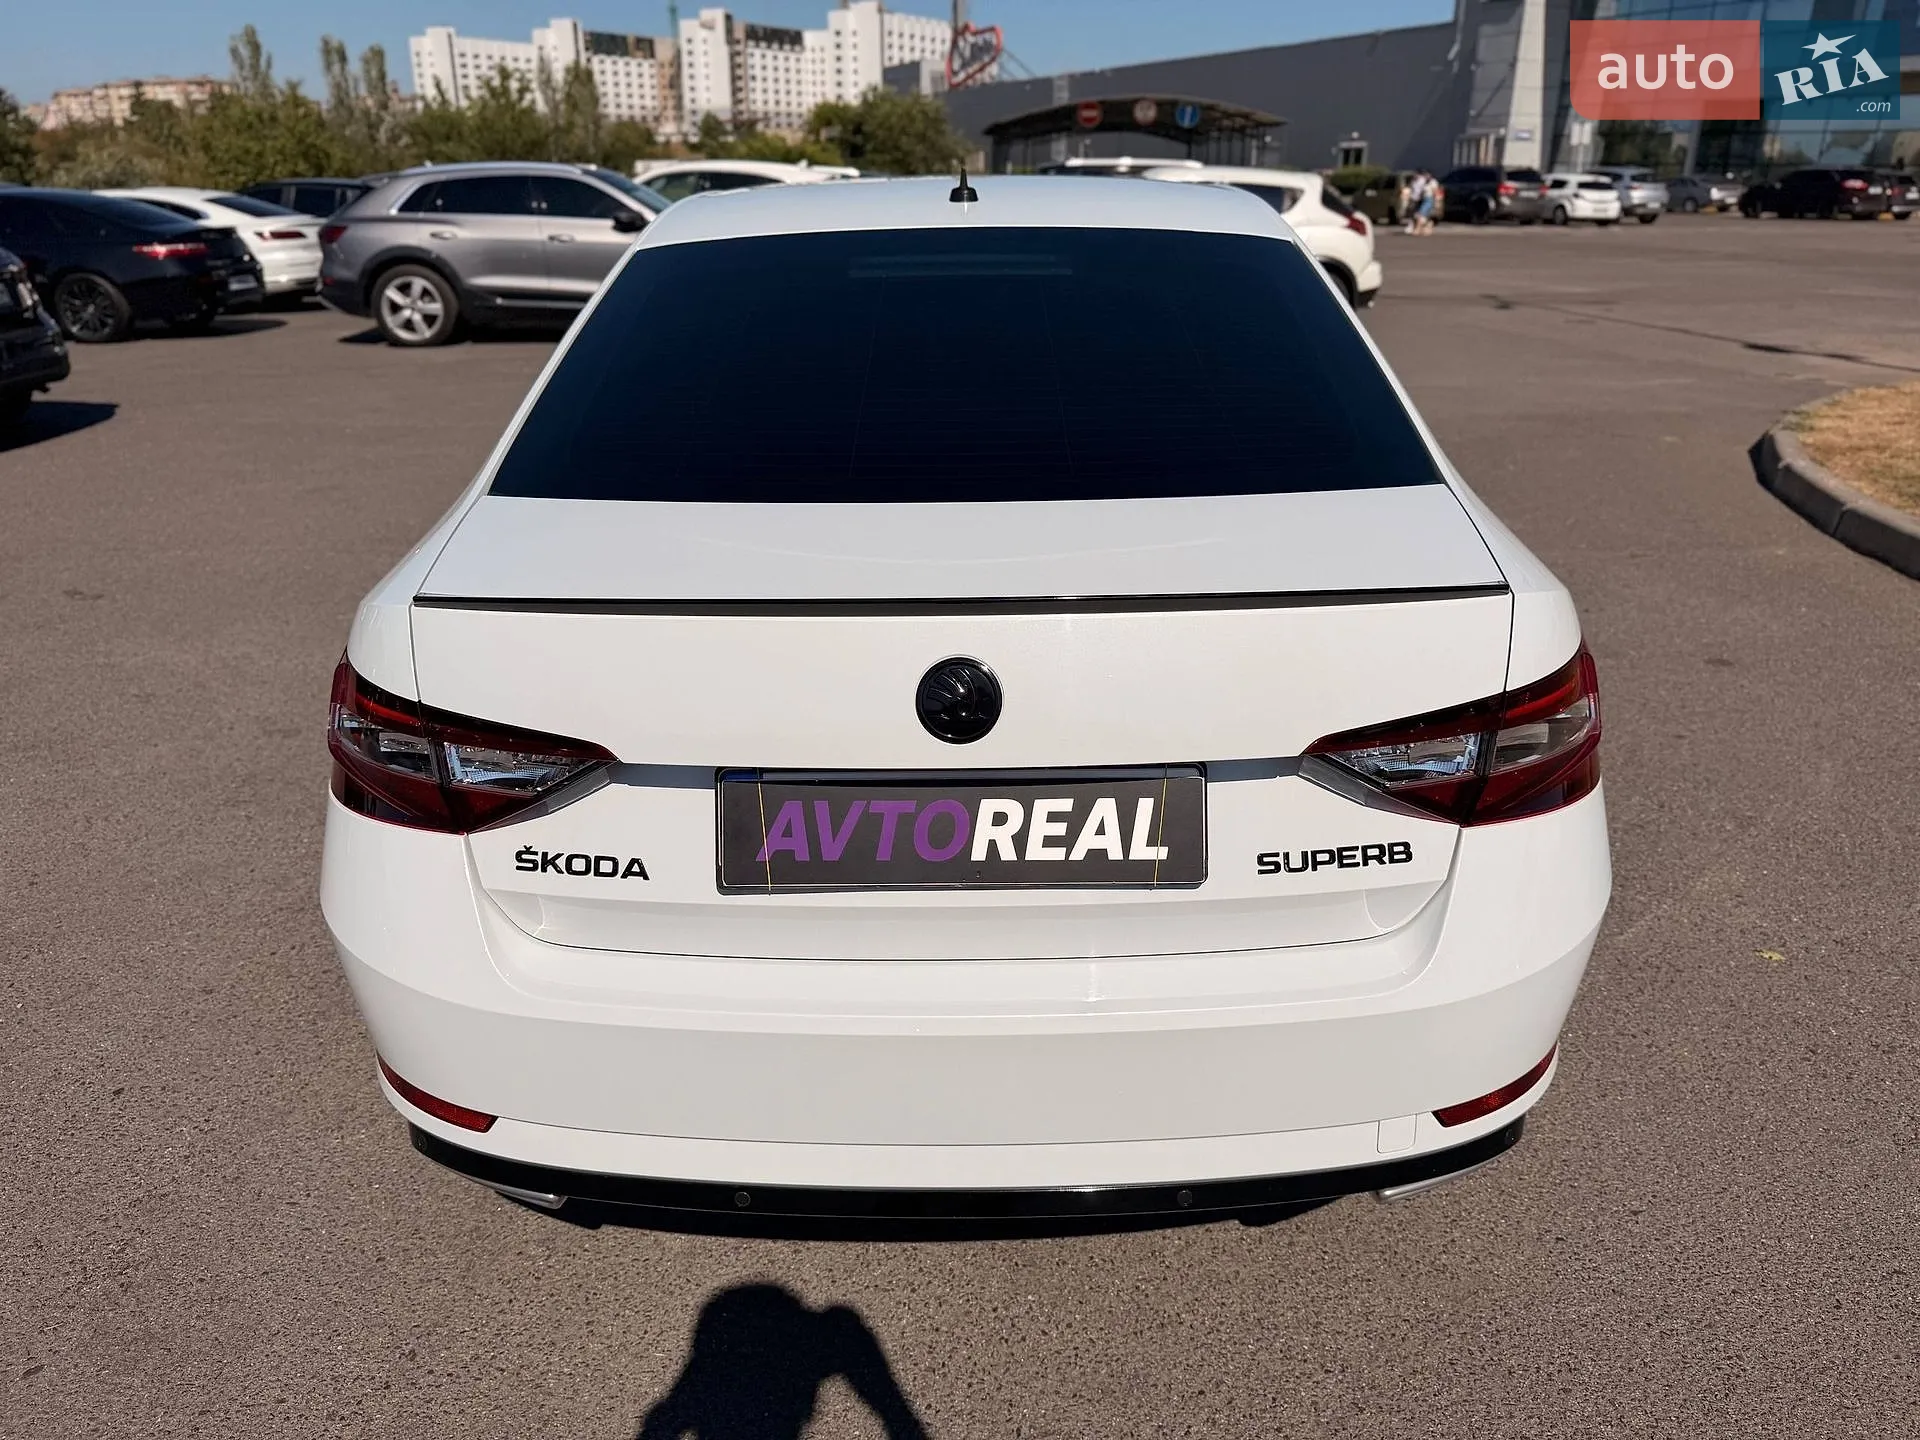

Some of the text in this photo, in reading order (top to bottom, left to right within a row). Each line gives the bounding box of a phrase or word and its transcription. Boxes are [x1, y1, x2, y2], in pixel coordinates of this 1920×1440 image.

[755, 797, 1170, 863] AVTOREAL
[514, 844, 651, 882] ŠKODA
[1256, 840, 1414, 876] SUPERB
